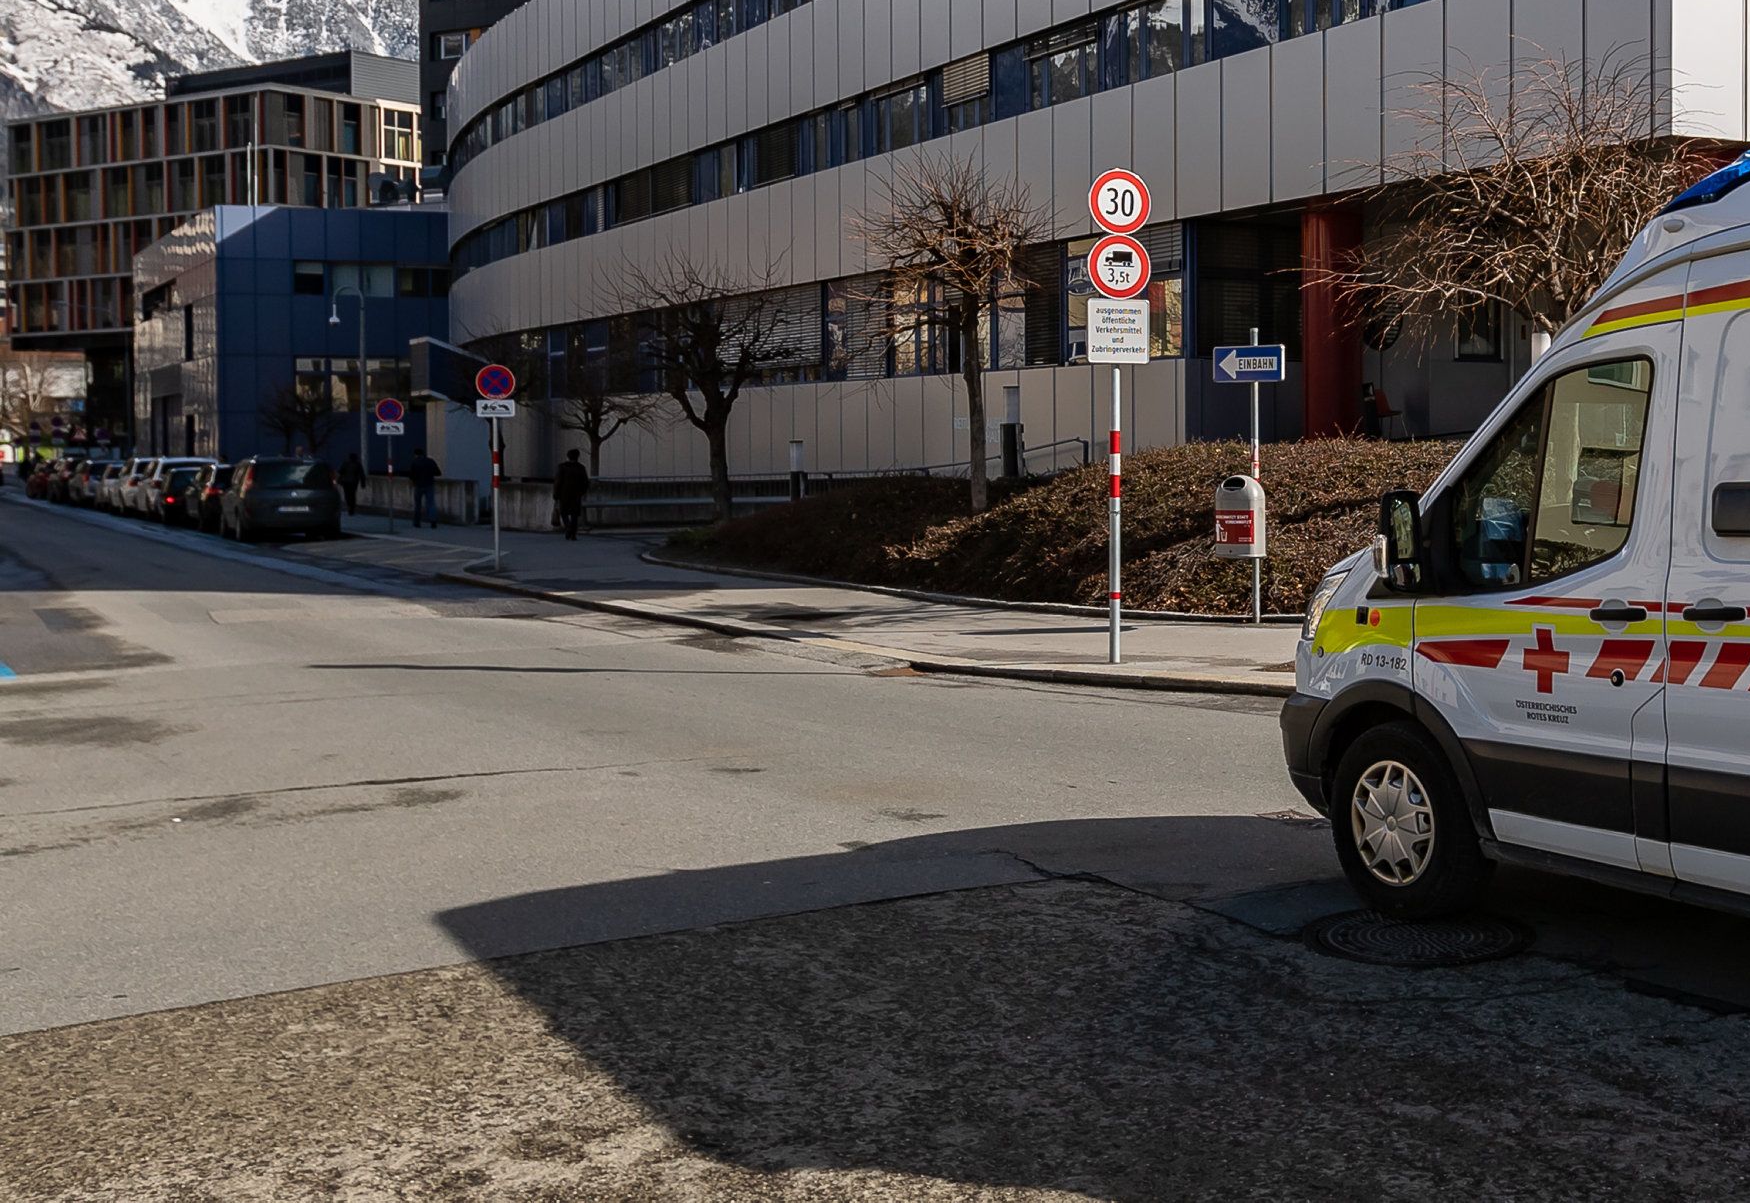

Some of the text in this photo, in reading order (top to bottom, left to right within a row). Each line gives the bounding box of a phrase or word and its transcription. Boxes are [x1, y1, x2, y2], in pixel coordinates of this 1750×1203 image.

[1105, 187, 1135, 217] 30
[1107, 267, 1131, 285] 3,5t
[1095, 307, 1142, 316] ausgenommen
[1101, 316, 1136, 324] öffentliche
[1095, 326, 1143, 335] Verkehrsmittel
[1111, 336, 1124, 344] und
[1238, 358, 1274, 369] EINBAHN
[1361, 653, 1407, 670] RD 13-182
[1515, 699, 1578, 714] ÖSTERREICHISCHES
[1526, 712, 1569, 724] ROTES KREUZ
